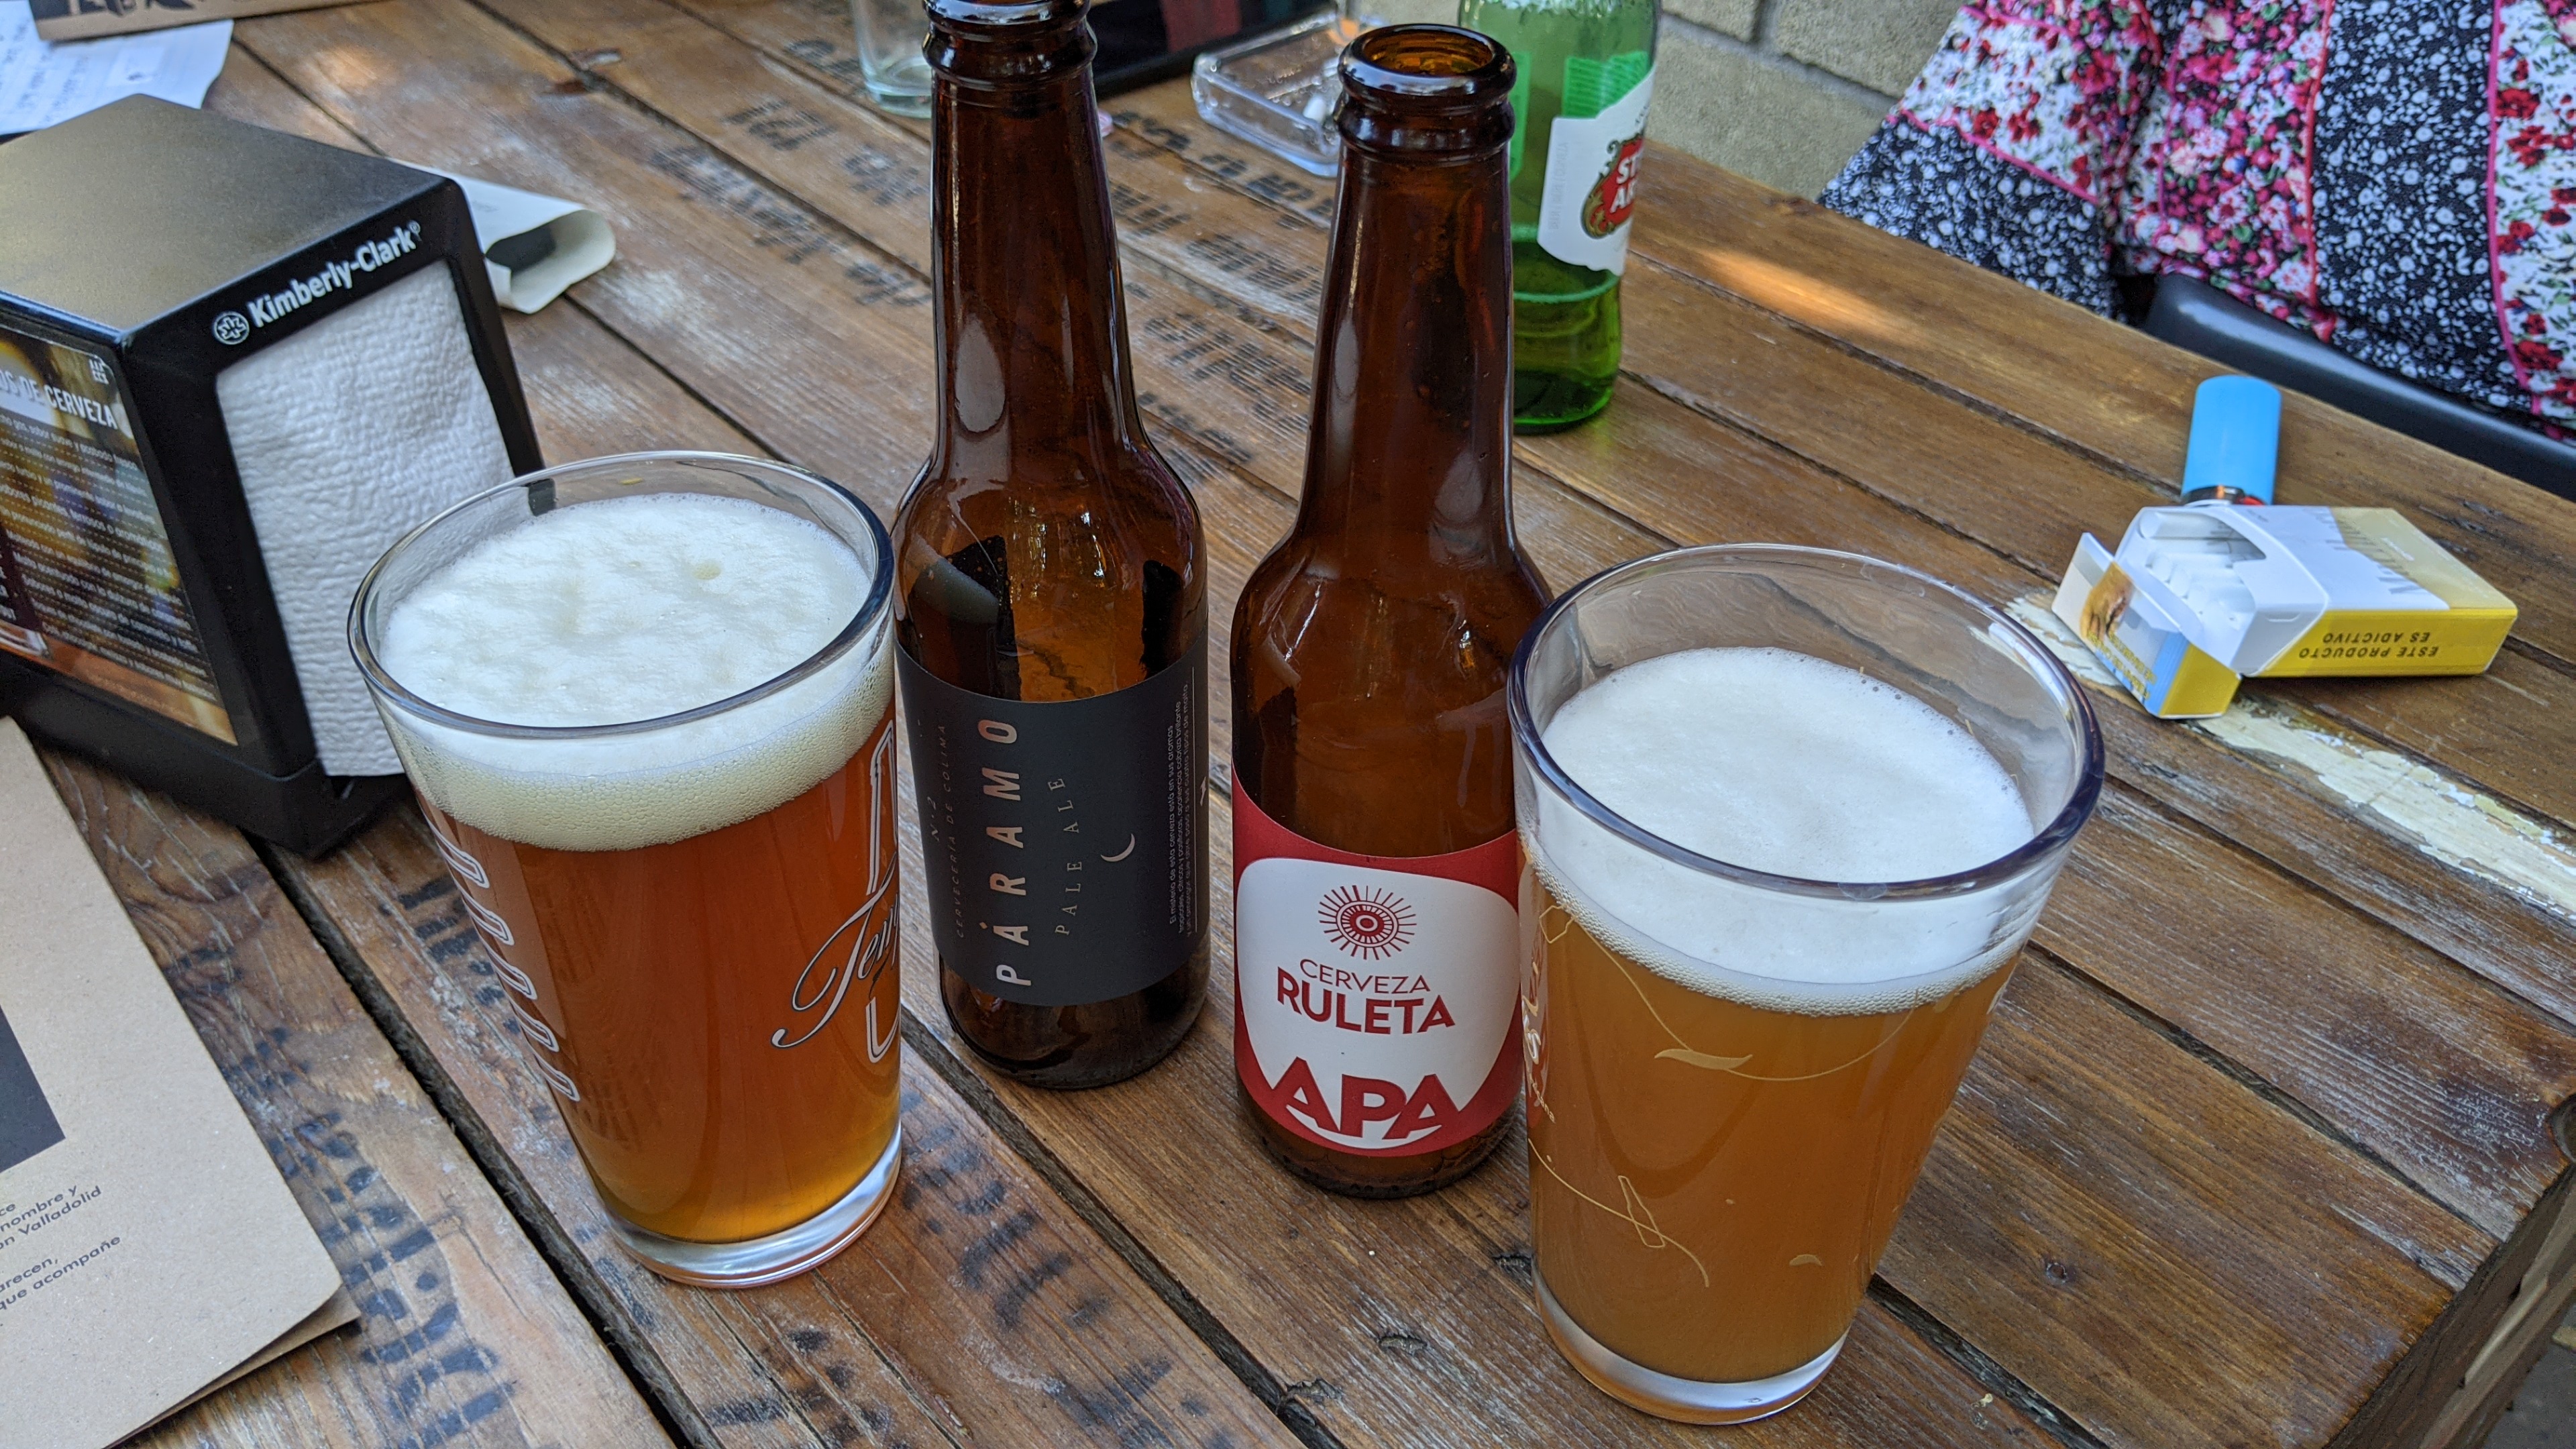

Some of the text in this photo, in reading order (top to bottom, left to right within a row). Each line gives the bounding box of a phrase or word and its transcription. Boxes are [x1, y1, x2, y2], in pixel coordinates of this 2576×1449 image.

[44, 384, 118, 430] CERVEZA
[2299, 646, 2439, 659] ESTE PRODUCTO
[2322, 632, 2430, 643] ES ADICTIVO
[937, 726, 951, 792] COLIMA
[945, 804, 954, 824] DE
[977, 719, 1032, 986] PÁRAMO
[1047, 778, 1083, 936] PALE ALE
[1277, 967, 1455, 1034] RULETA
[1299, 959, 1430, 994] CERVEZA
[1273, 1056, 1460, 1140] APA
[0, 1185, 77, 1232] nombre y
[18, 1185, 102, 1235] Valladolid
[33, 1236, 121, 1289] acompañe
